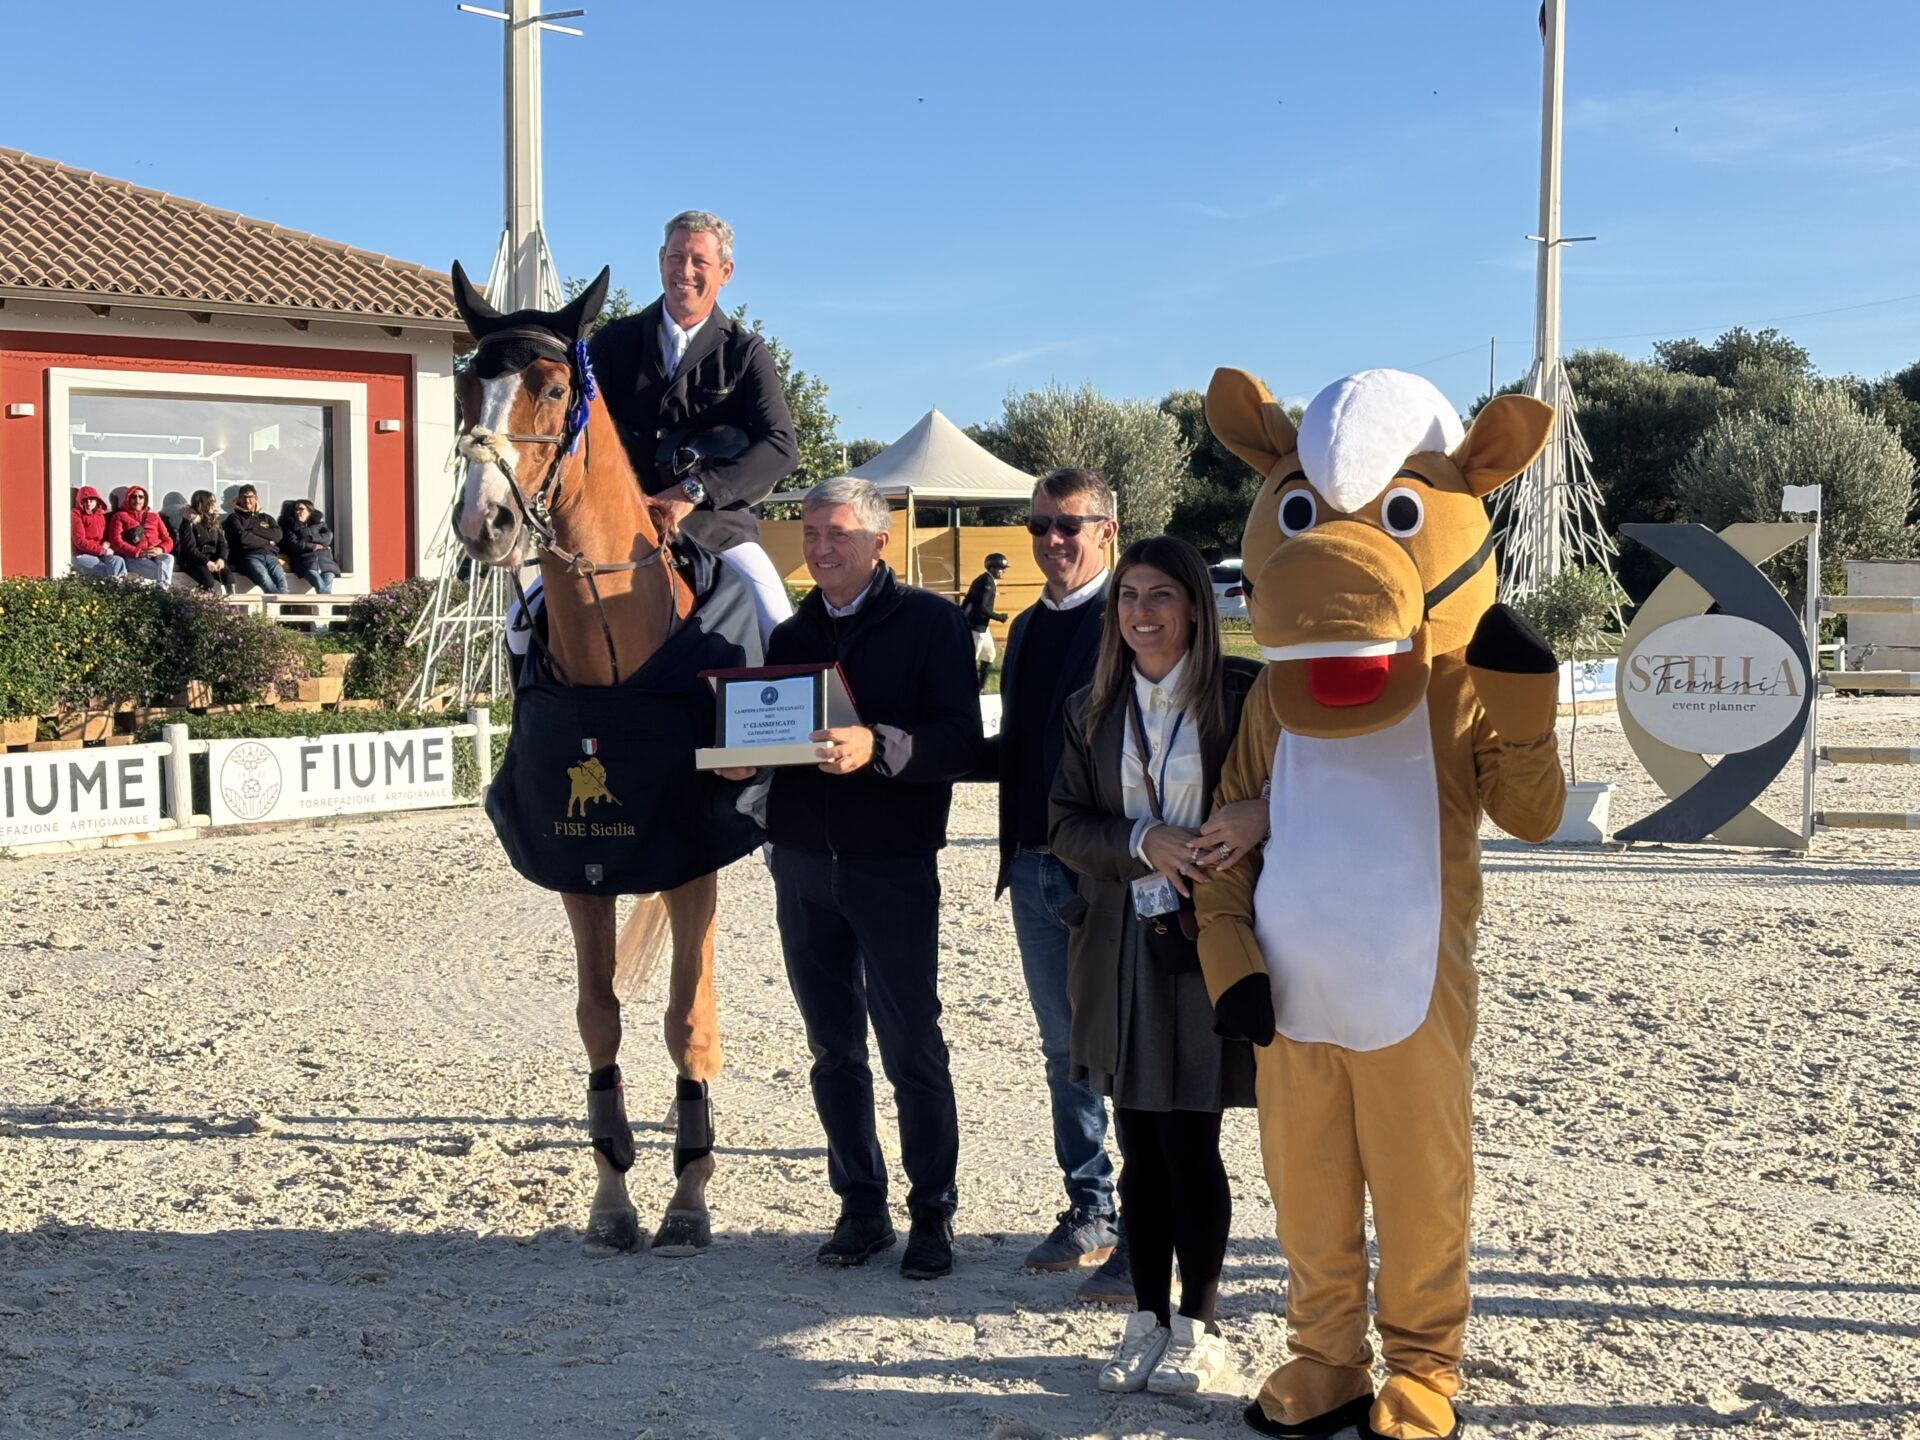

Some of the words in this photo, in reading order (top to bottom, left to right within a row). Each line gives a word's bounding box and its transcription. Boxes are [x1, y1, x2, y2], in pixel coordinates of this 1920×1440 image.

[1629, 654, 1802, 696] STELLA
[1672, 702, 1705, 711] event
[1709, 700, 1757, 713] planner
[749, 720, 796, 728] CLASSIFICATO
[300, 737, 444, 792] FIUME
[4, 758, 145, 818] IUME
[299, 794, 377, 809] TORREFAZIONE
[385, 788, 447, 802] ARTIGIANALE
[70, 814, 149, 830] ARTIGIANALE
[554, 821, 587, 837] FISE
[590, 822, 636, 837] Sicilia
